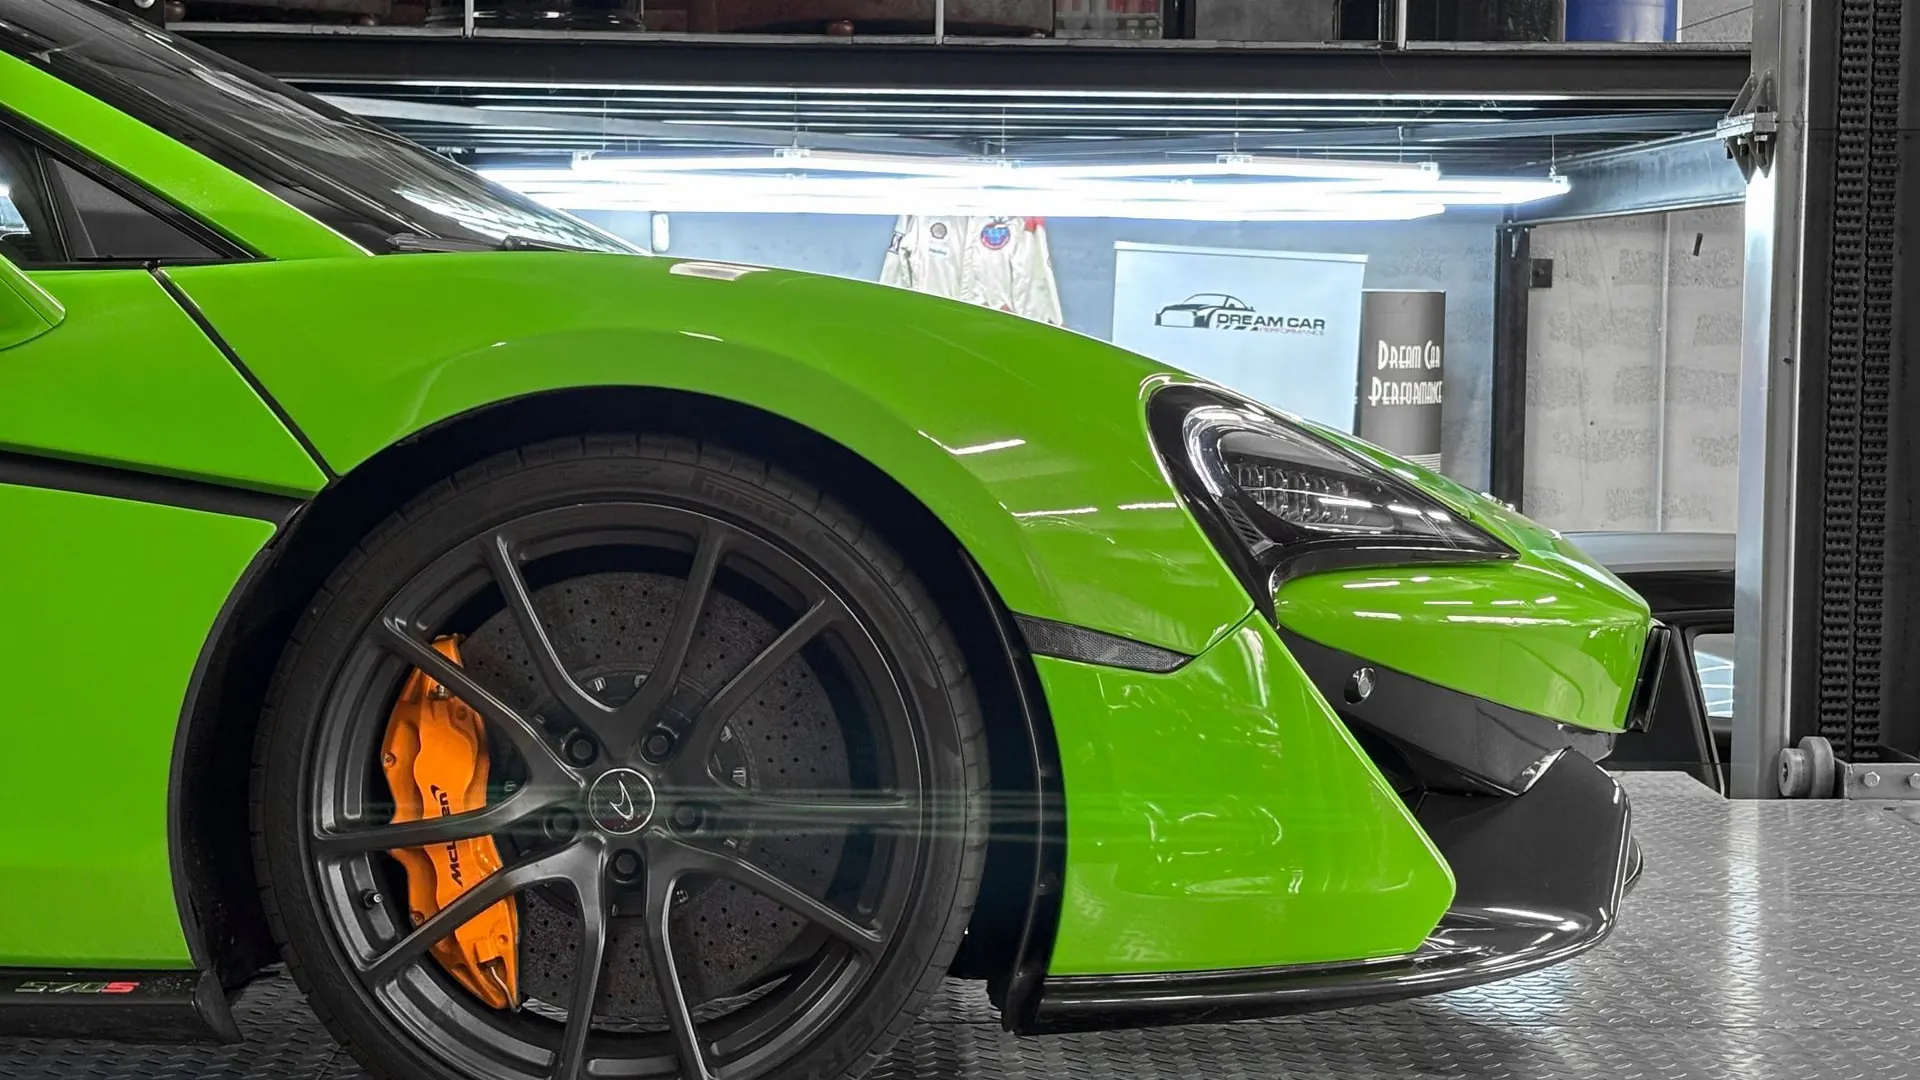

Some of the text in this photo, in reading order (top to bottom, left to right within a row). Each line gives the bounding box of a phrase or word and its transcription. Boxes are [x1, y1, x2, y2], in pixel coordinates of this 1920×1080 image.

[1217, 313, 1326, 330] DREAM CAR
[14, 981, 141, 993] 570S
